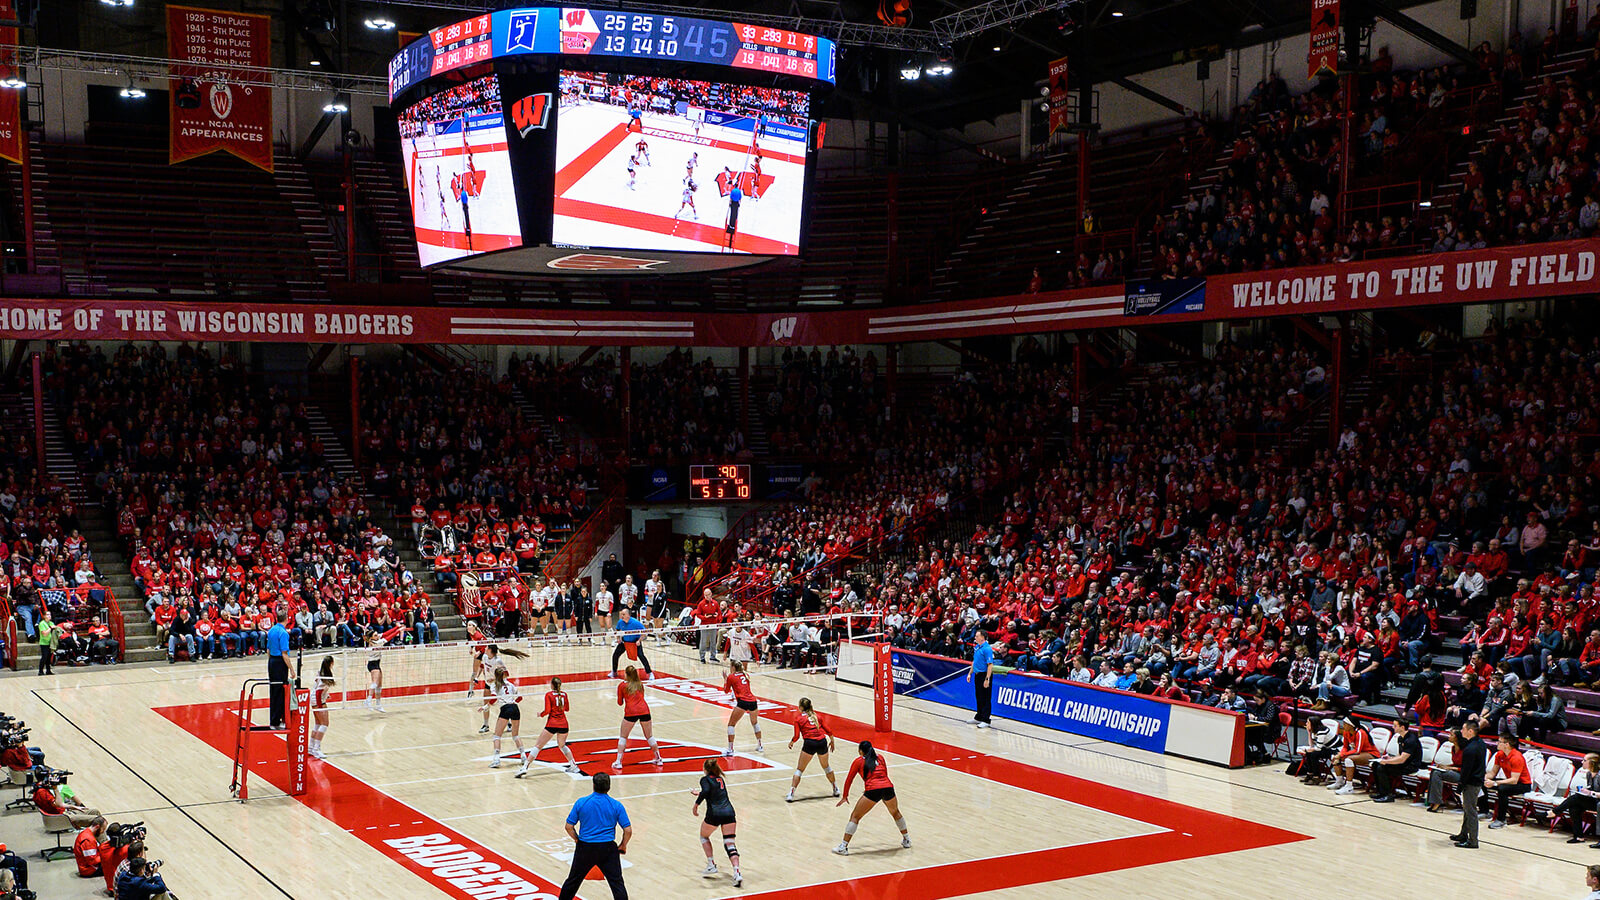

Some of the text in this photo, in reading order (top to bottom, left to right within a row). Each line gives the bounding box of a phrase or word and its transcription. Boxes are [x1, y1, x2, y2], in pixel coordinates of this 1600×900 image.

[186, 13, 205, 22] 1928
[186, 24, 205, 33] 1941
[604, 15, 674, 33] 25 25 5
[435, 16, 488, 45] 33 .293 11 75
[186, 35, 206, 44] 1976
[742, 27, 814, 49] 33 .293 11 75
[187, 45, 206, 54] 1978
[479, 44, 488, 57] 73
[604, 36, 626, 52] 13
[632, 38, 653, 54] 14
[657, 40, 678, 56] 10
[742, 43, 758, 51] KILLS
[742, 52, 814, 74] 19 .041 16 73
[209, 120, 234, 128] NCAA
[181, 128, 263, 142] APPEARANCES
[1232, 251, 1597, 308] WELCOME TO THE UW FIELD
[0, 308, 415, 336] HOME OF THE WISCONSIN BADGERS
[771, 317, 797, 341] W
[703, 486, 710, 498] 5
[717, 488, 724, 498] 3
[738, 486, 749, 497] 10
[740, 676, 747, 685] 2
[504, 686, 509, 694] 2
[298, 693, 309, 703] W
[997, 686, 1162, 738] VOLLEYBALL CHAMPIONSHIP
[296, 706, 307, 791] WISCONSIN
[717, 778, 724, 789] 7
[382, 833, 560, 900] BADGER
